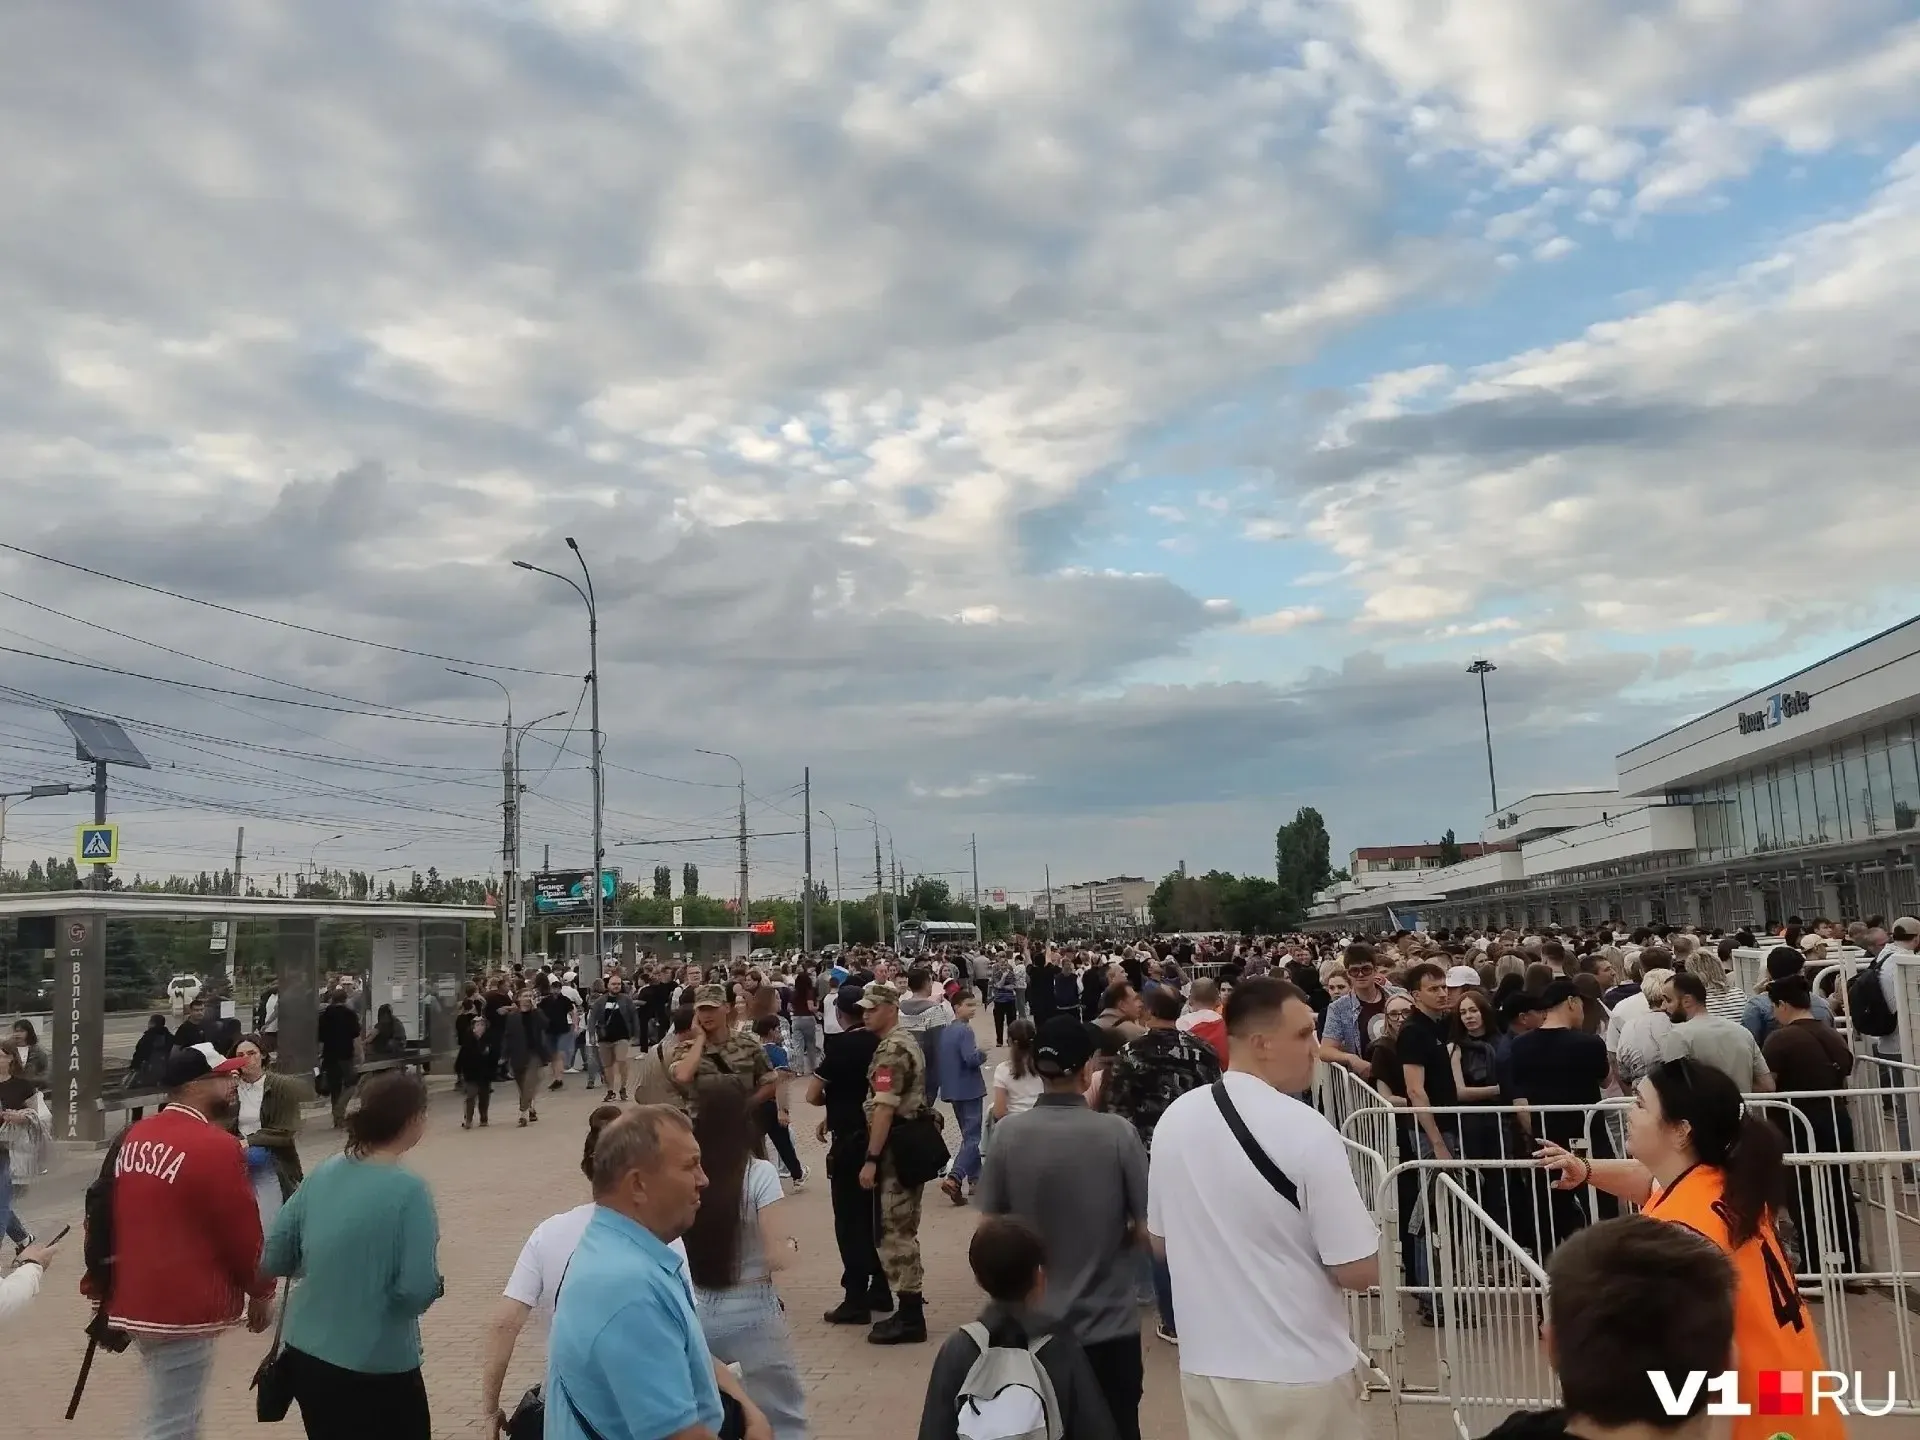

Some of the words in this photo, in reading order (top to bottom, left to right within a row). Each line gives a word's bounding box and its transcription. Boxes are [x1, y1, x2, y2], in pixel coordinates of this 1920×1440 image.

[1782, 690, 1810, 719] Gate
[69, 961, 81, 1071] ВОЛГОГРАД
[68, 1077, 78, 1137] АРЕНА
[115, 1140, 186, 1184] RUSSIA
